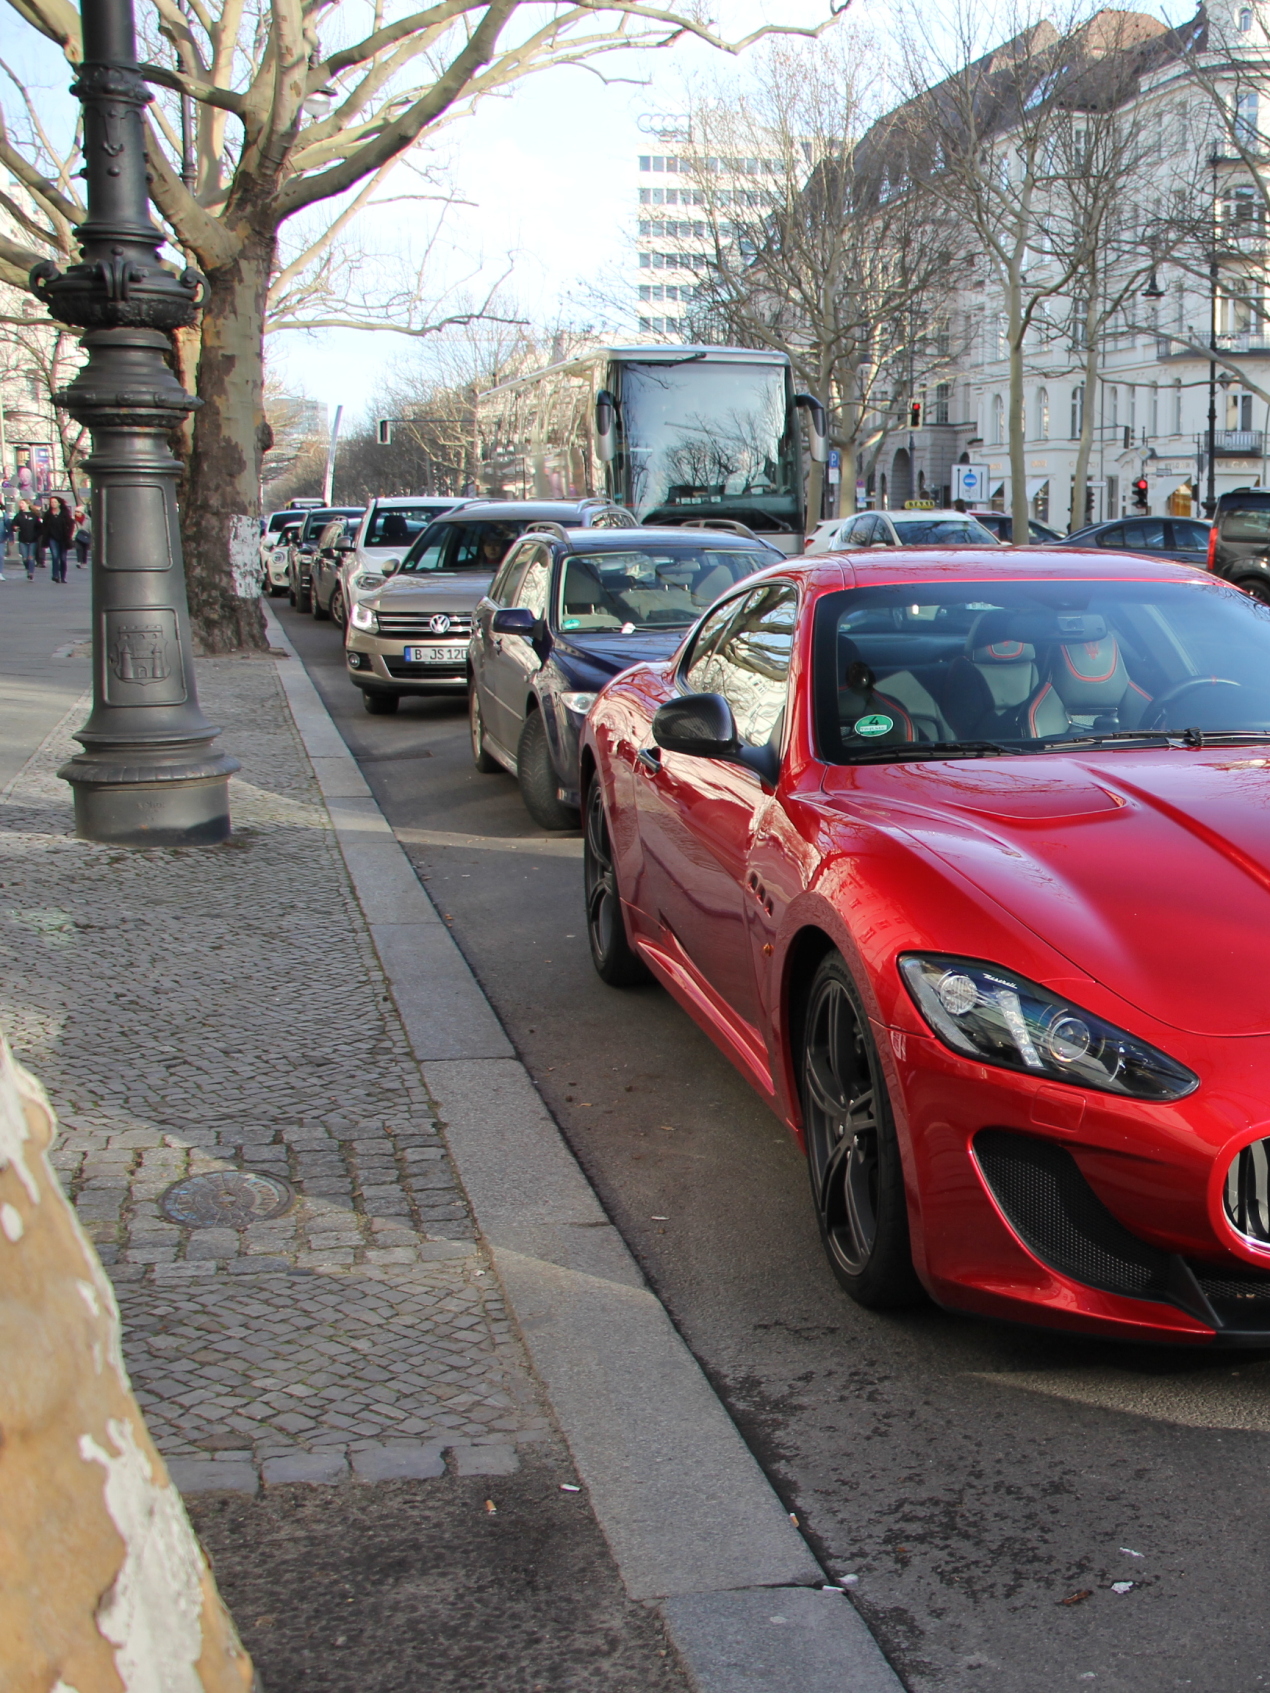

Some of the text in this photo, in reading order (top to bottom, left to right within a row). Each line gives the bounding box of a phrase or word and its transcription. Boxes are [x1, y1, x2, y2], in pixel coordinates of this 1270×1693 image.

[831, 453, 837, 465] P
[415, 649, 423, 660] B
[869, 716, 879, 726] 4
